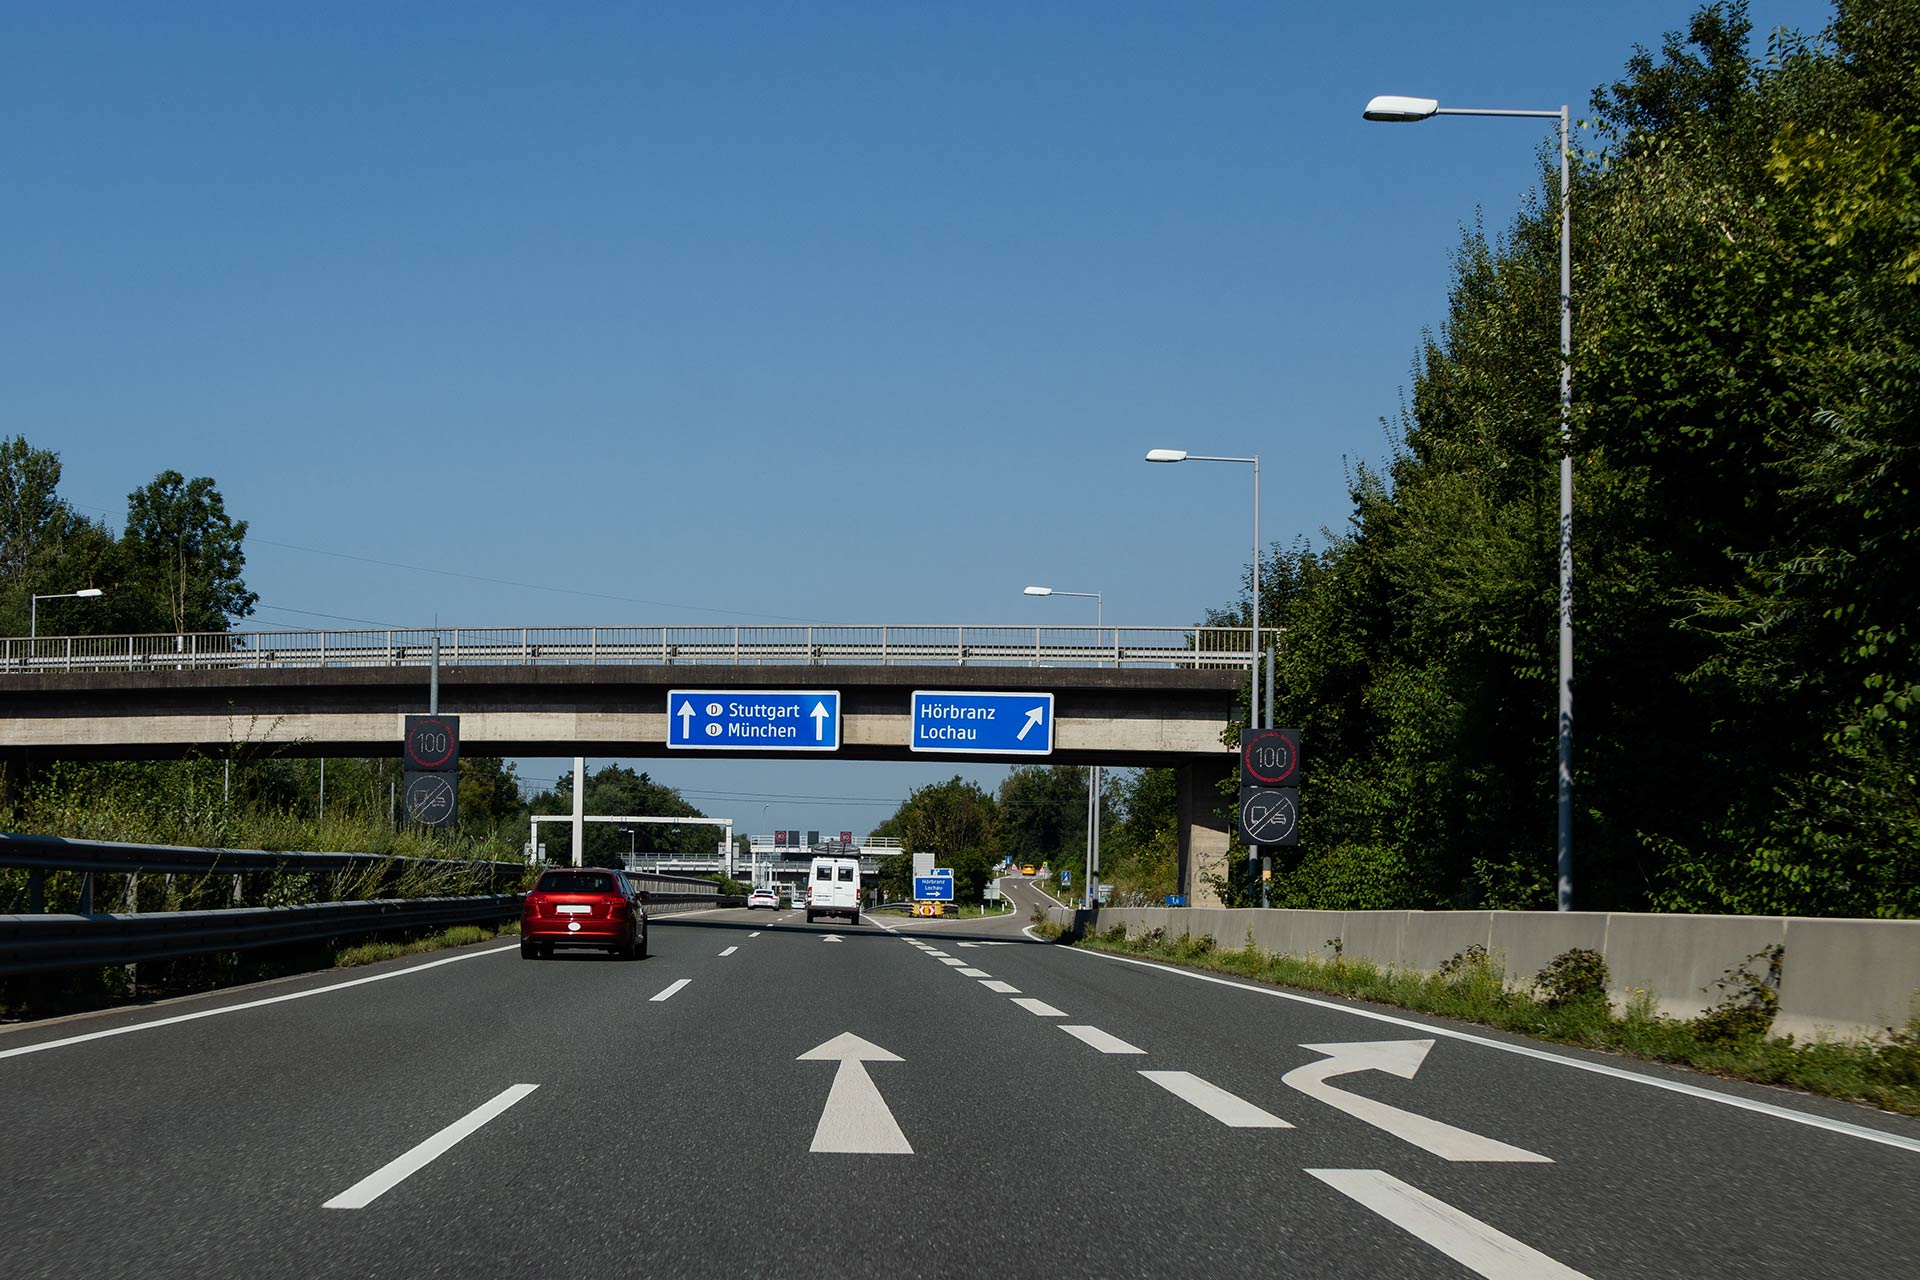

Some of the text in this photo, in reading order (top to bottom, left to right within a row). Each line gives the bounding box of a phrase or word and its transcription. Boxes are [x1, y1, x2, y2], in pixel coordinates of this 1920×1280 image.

[710, 702, 800, 721] D Stuttgart
[920, 703, 996, 720] Hörbranz
[710, 722, 797, 738] D München
[920, 724, 977, 740] Lochau
[417, 733, 446, 753] 100
[1256, 747, 1287, 768] 100
